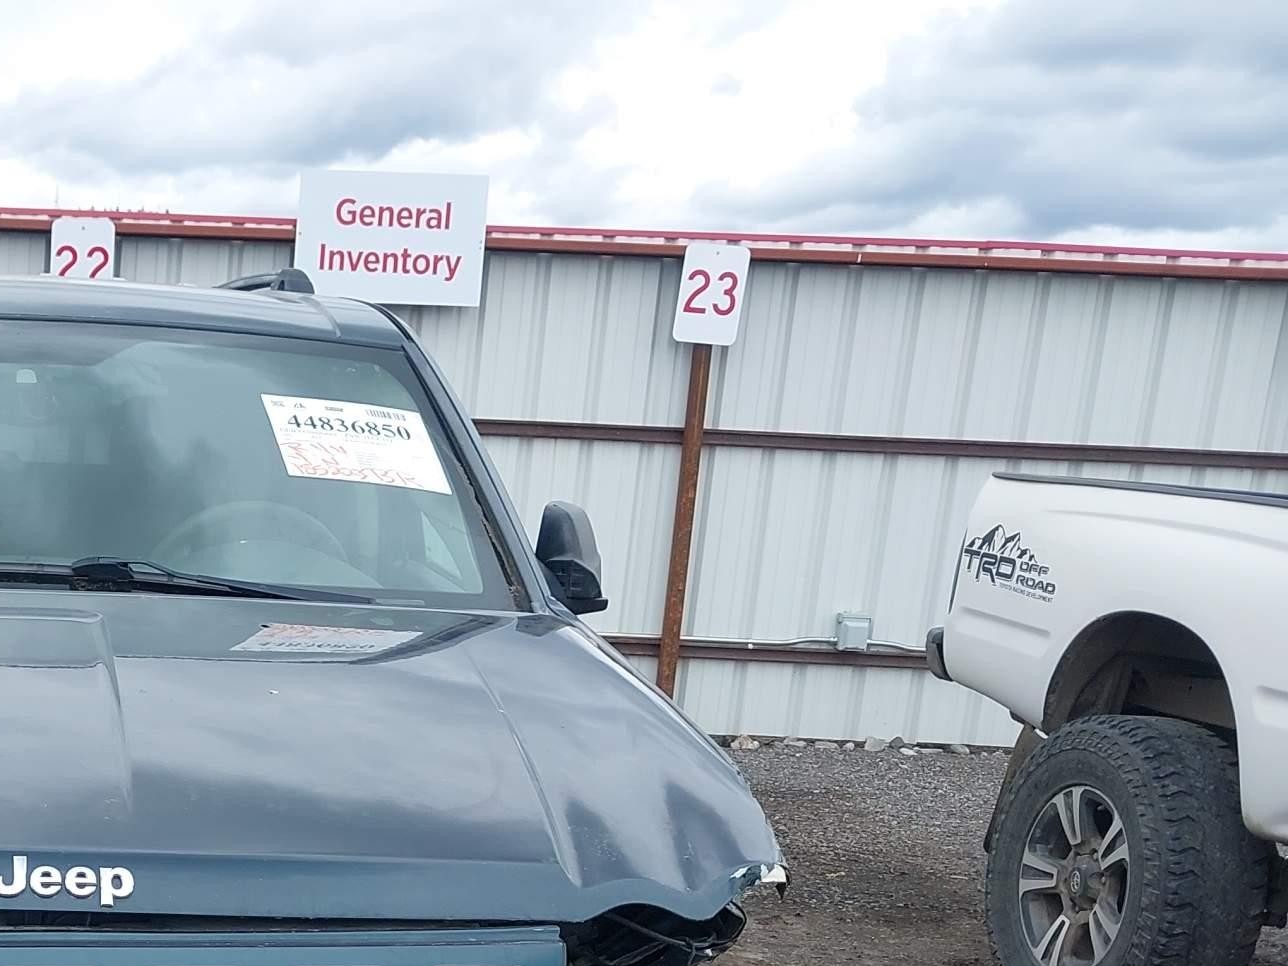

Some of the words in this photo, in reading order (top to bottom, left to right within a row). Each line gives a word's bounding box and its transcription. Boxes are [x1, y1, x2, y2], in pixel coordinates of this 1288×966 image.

[335, 198, 452, 230] General
[318, 243, 462, 281] Inventory
[683, 269, 738, 316] 23
[287, 414, 411, 441] 44836850
[1019, 560, 1050, 577] OFF
[1015, 574, 1056, 595] ROAD
